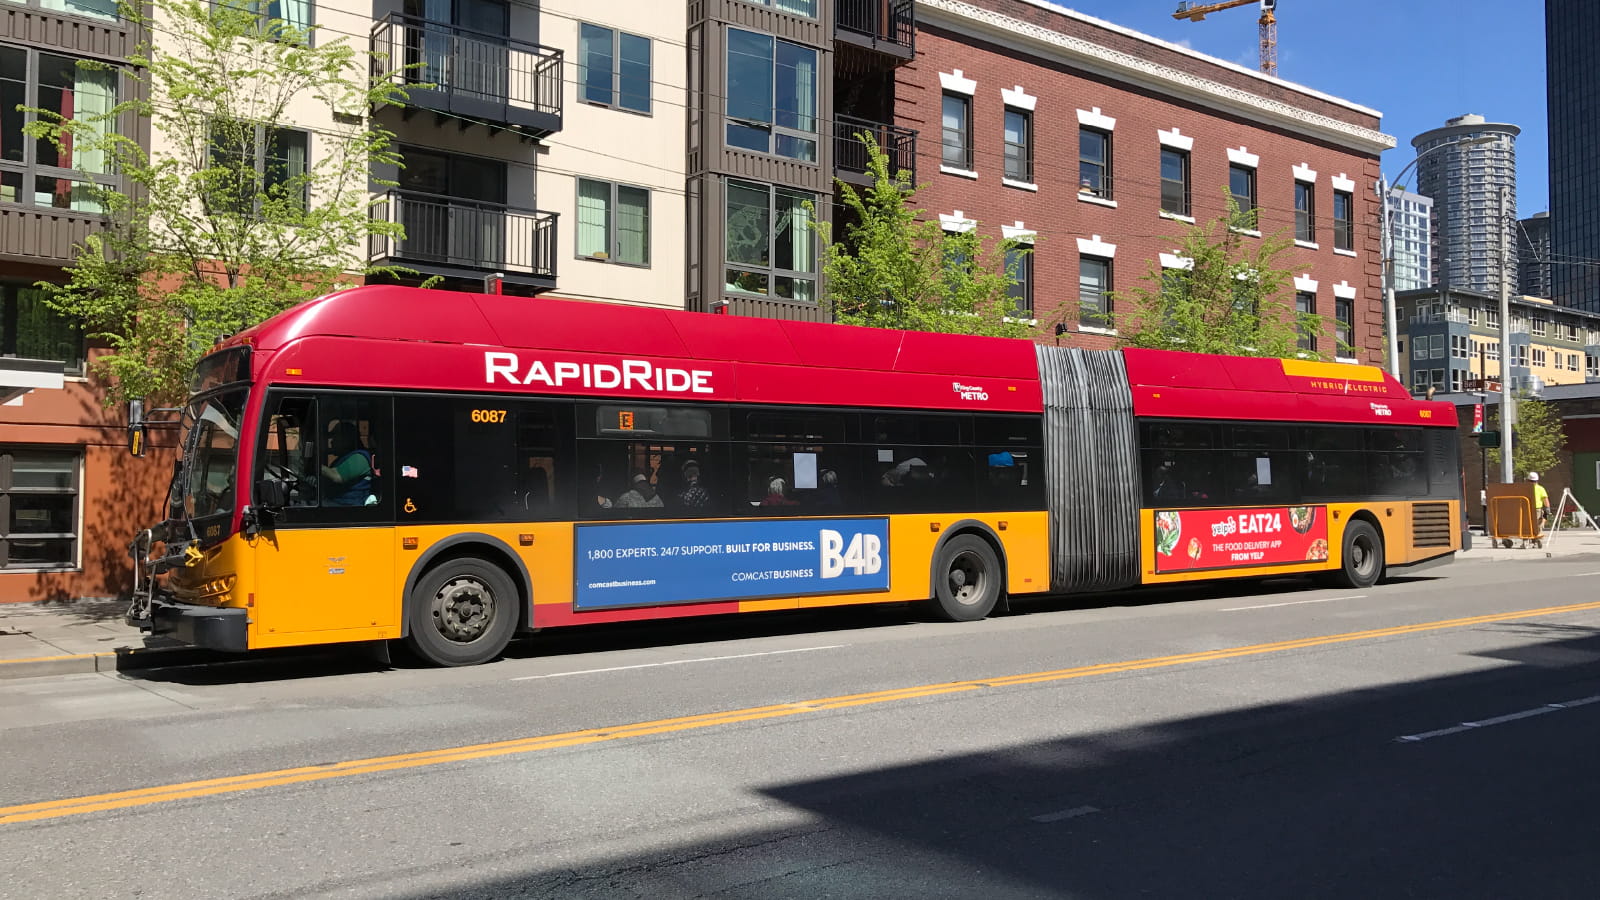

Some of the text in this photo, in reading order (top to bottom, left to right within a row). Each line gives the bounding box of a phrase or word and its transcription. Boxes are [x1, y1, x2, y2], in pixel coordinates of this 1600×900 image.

[1310, 380, 1388, 393] HYBRID ELECTRIC
[961, 391, 989, 401] METRO
[471, 409, 507, 424] 6087
[1374, 408, 1392, 416] METRO
[619, 411, 634, 430] E
[1239, 512, 1282, 534] EAT24
[587, 541, 816, 561] 1,800 EXPERTS. 24/7 SUPPORT. BUILT FOR BUSINESS.
[1212, 540, 1282, 552] THE FOOD DELIVERY APP
[819, 528, 882, 579] B4B
[1231, 551, 1265, 561] FROM YELP
